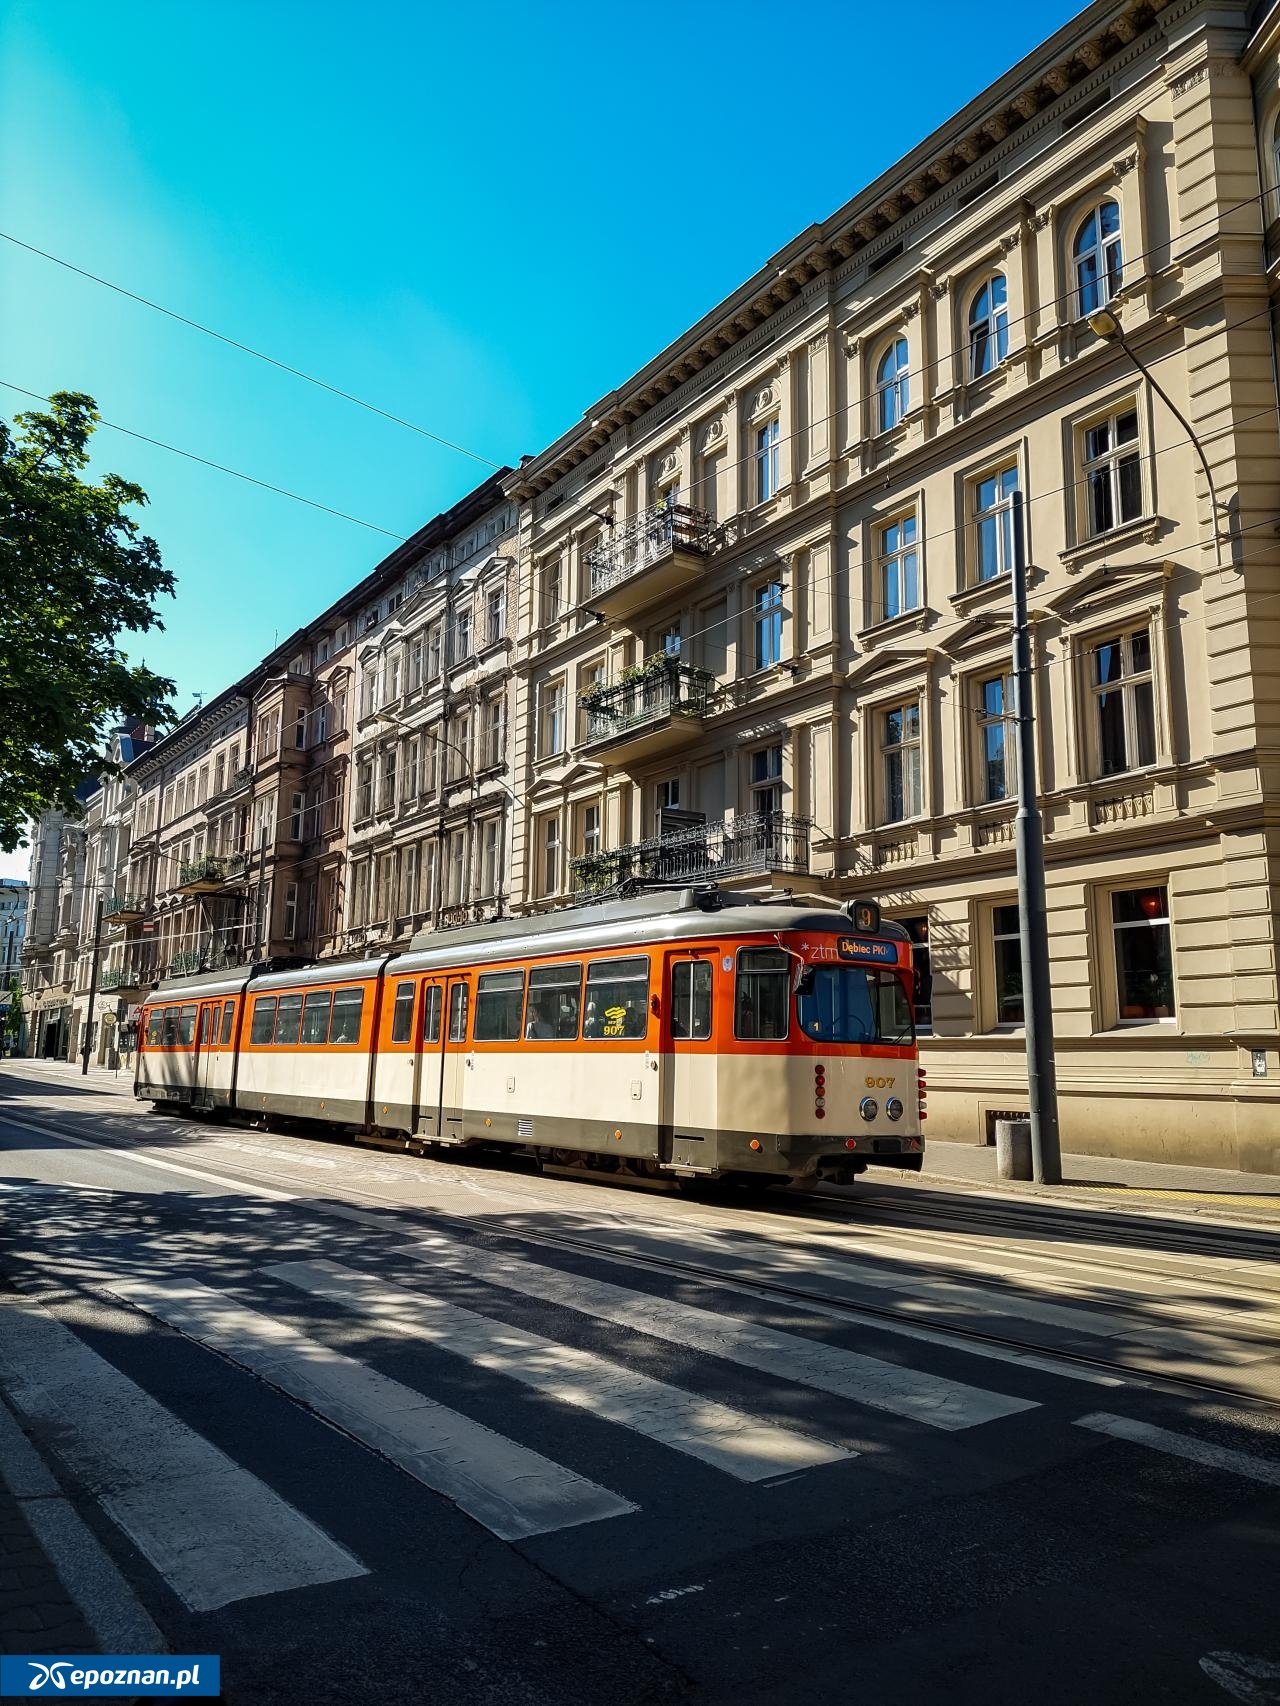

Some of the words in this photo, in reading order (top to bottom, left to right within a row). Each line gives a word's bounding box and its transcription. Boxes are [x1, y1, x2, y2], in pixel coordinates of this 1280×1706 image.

[860, 907, 872, 927] 9
[841, 941, 871, 955] Dębiec
[603, 1025, 625, 1036] 907
[813, 1021, 819, 1032] 1
[864, 1076, 896, 1089] 907
